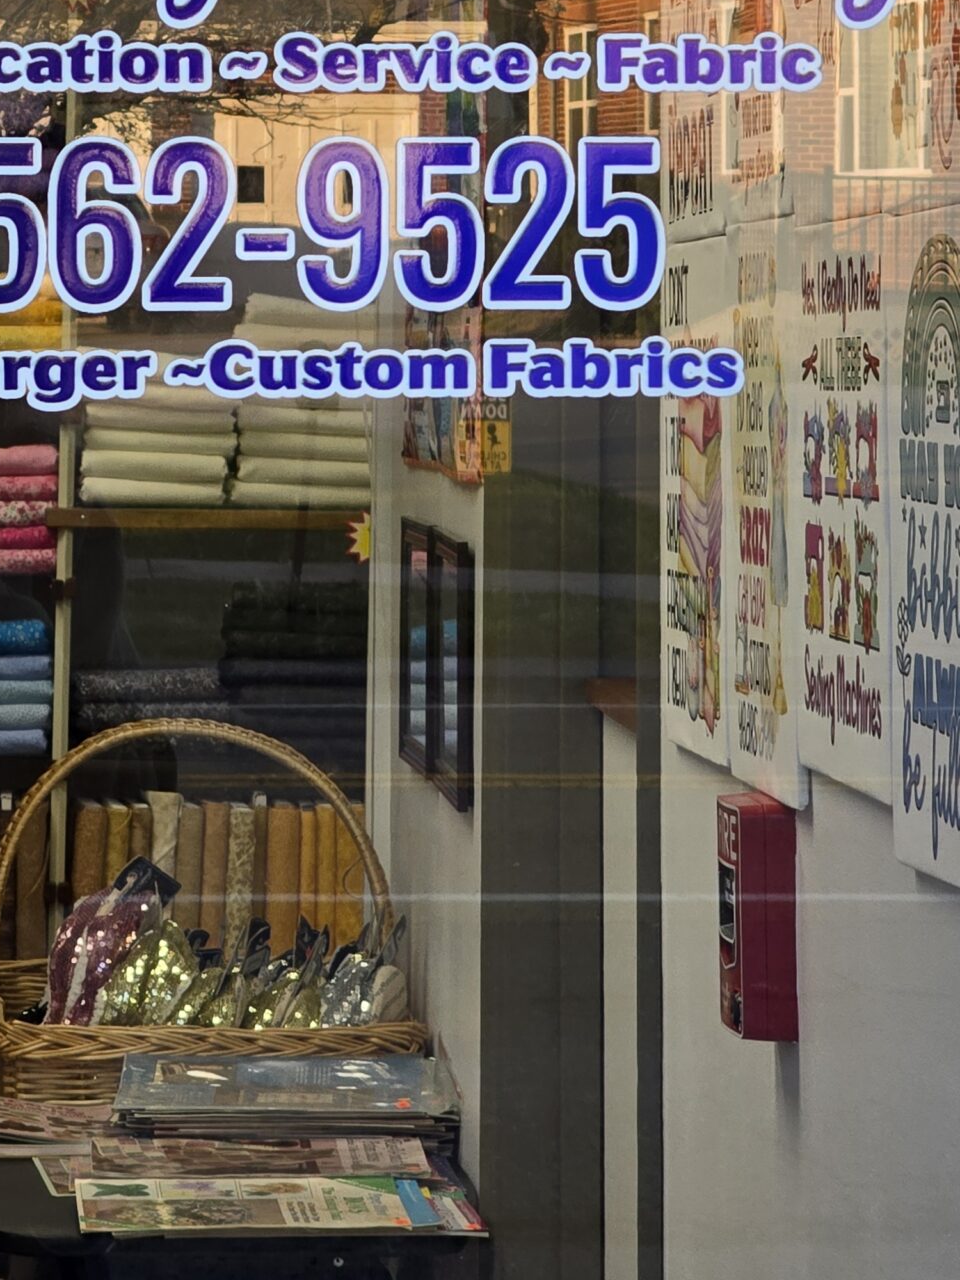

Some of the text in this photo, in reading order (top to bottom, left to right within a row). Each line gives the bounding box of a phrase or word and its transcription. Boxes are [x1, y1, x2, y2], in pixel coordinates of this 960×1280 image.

[278, 33, 532, 87] Service
[601, 32, 819, 89] Fabric
[822, 255, 846, 332] Really
[847, 256, 859, 313] Do
[860, 254, 881, 312] Need
[490, 340, 739, 395] Fabrics
[820, 337, 835, 391] ALL
[900, 438, 939, 504] MAY
[804, 643, 882, 746] Sewing Machines
[903, 699, 927, 814] be
